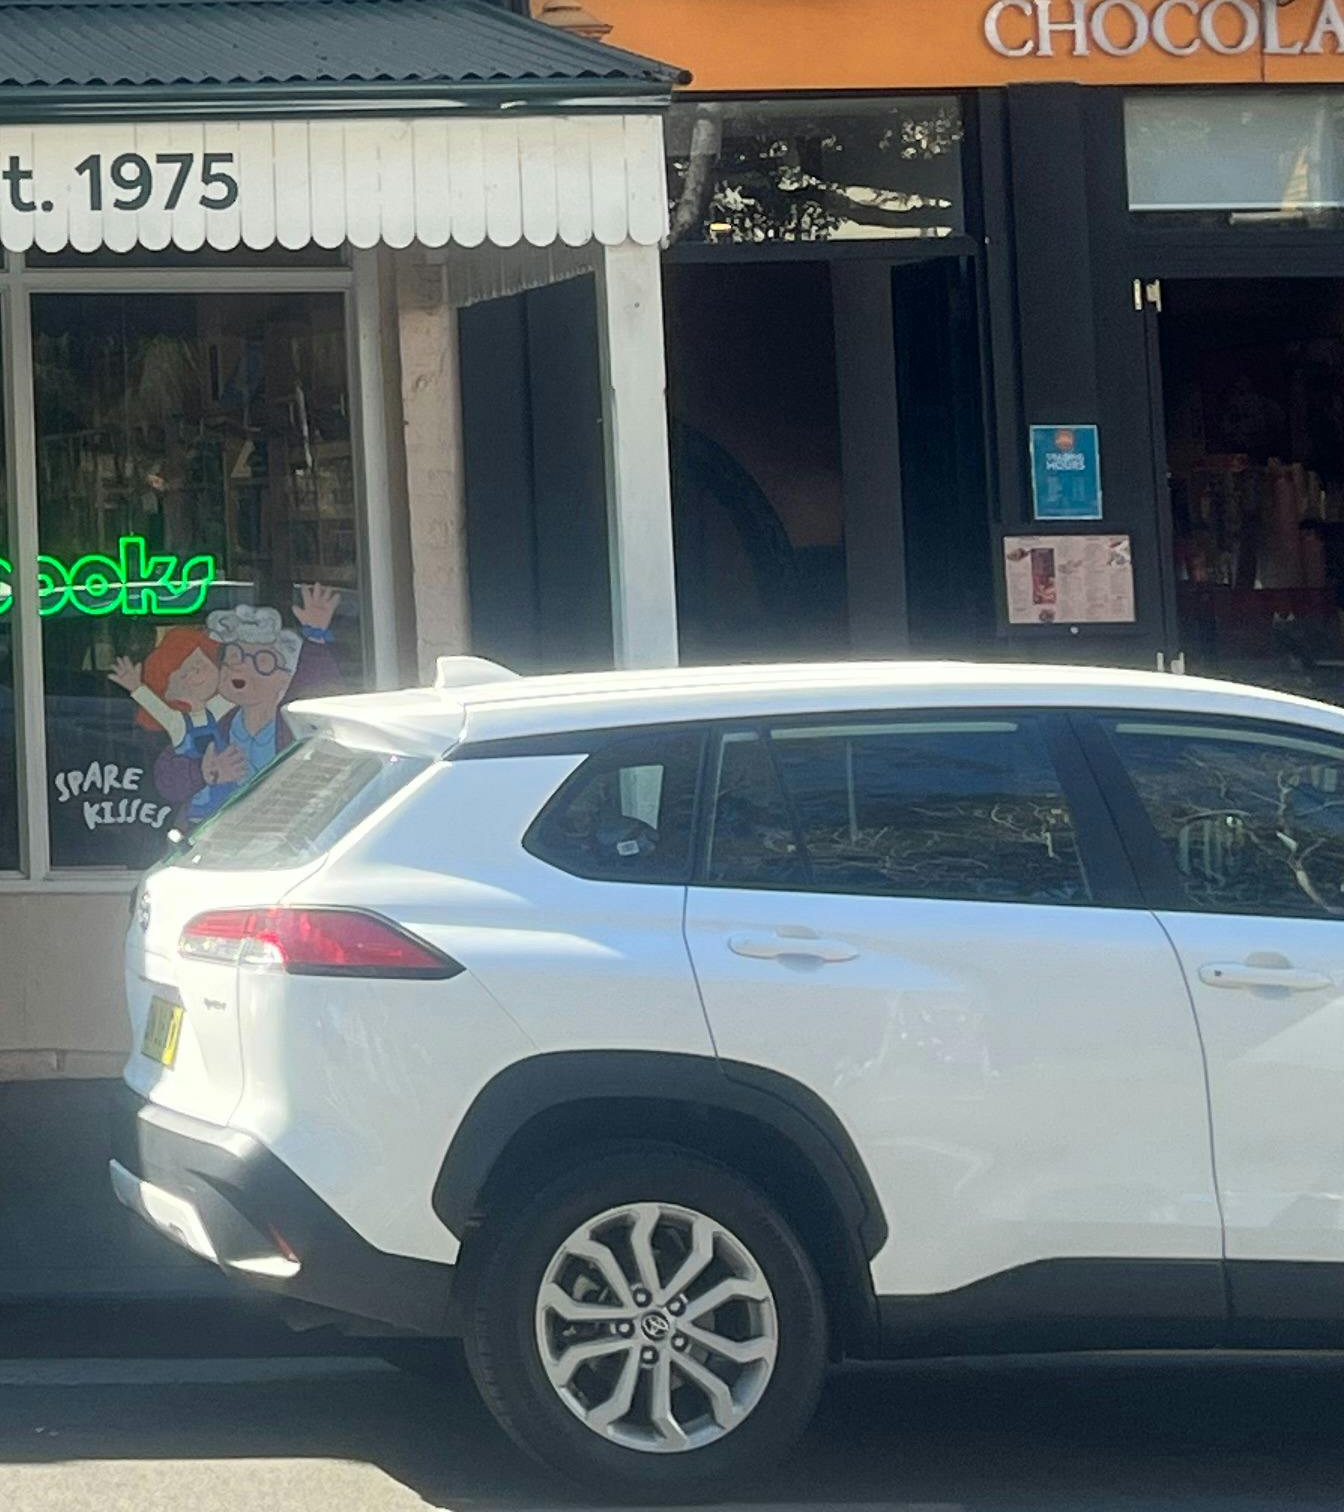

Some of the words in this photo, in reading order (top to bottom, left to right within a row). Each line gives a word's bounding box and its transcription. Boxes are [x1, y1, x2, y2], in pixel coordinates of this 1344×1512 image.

[74, 152, 239, 212] 1975
[54, 761, 144, 803] SPARE
[83, 798, 172, 830] KISSES
